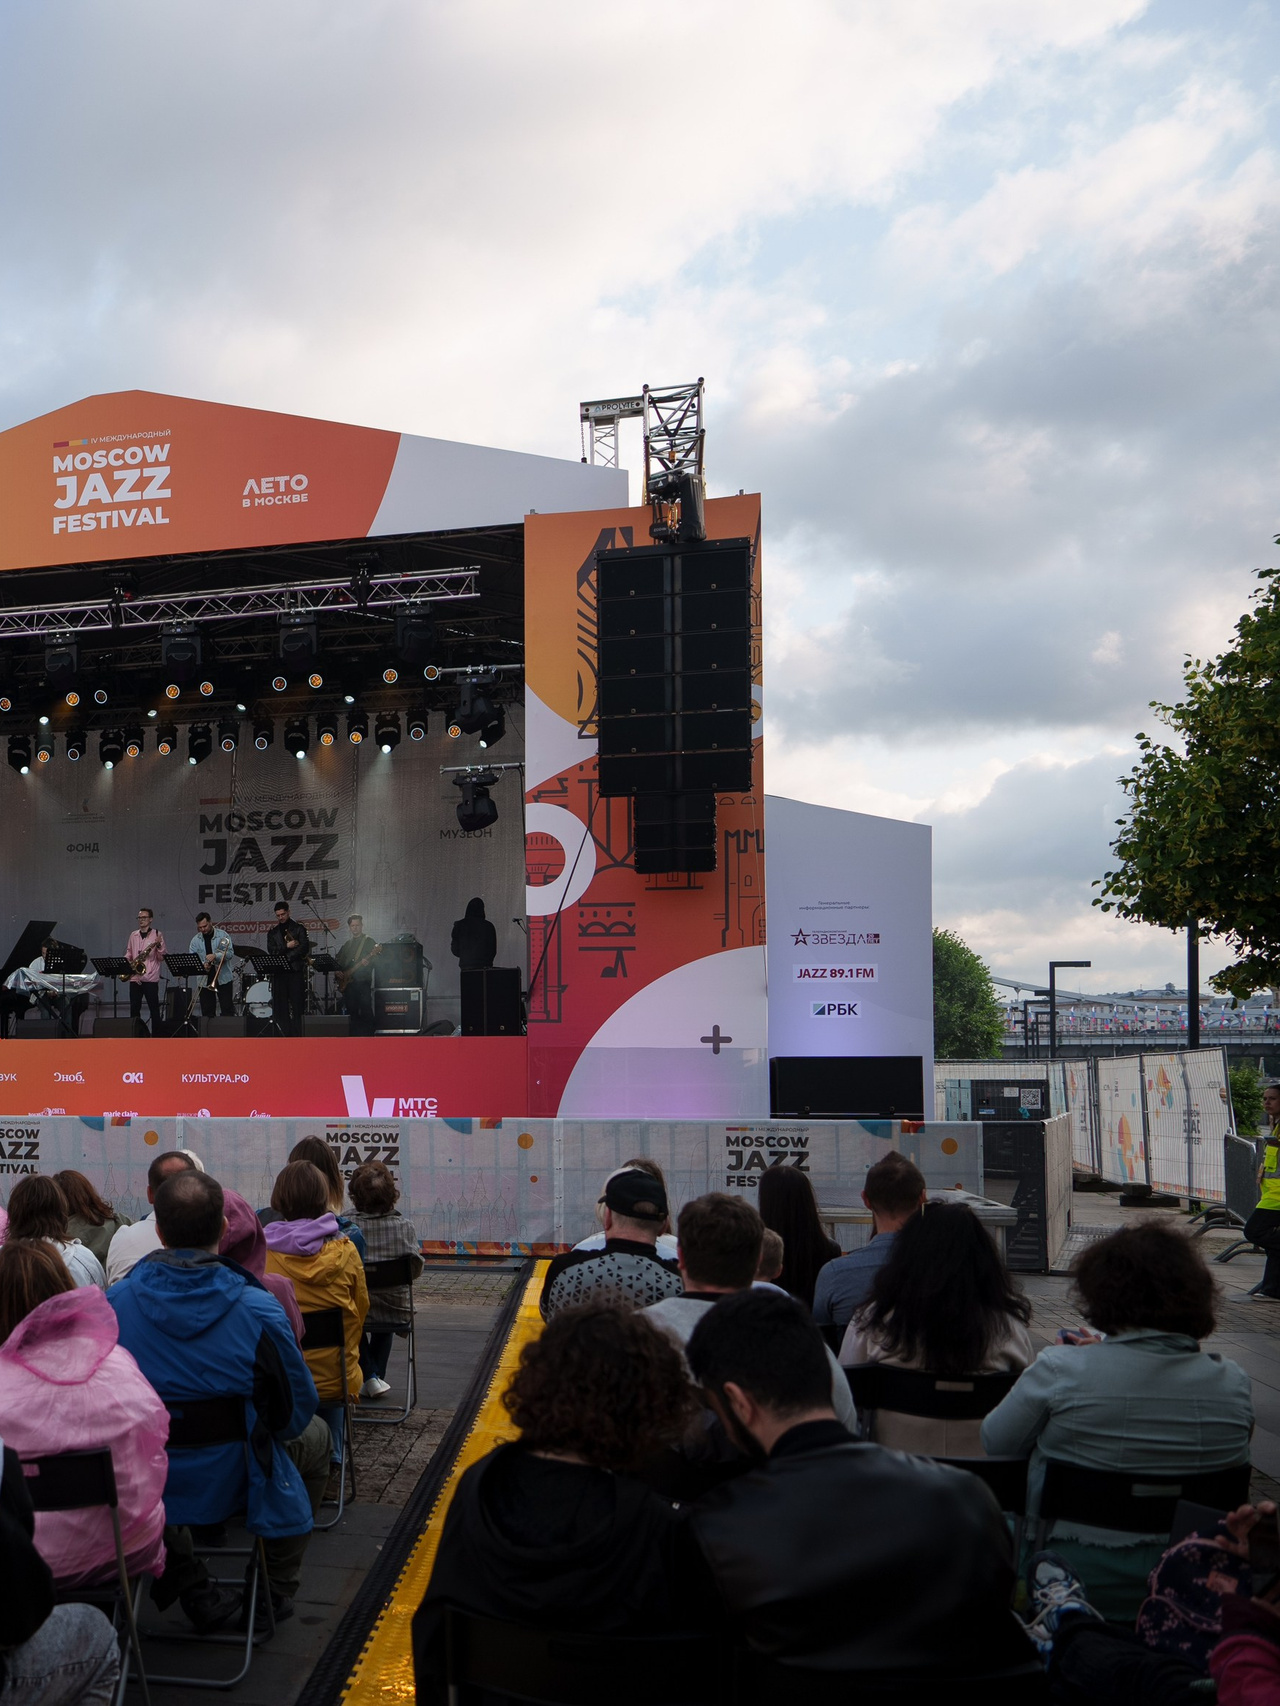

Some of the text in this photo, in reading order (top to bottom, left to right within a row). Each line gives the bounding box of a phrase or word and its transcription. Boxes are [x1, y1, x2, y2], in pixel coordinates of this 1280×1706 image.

[601, 402, 634, 411] PROLYTE
[99, 429, 171, 443] МЕЖДУНАРОДНЫЙ
[53, 443, 171, 473] MOSCOW
[53, 466, 171, 509] JAZZ
[243, 474, 309, 496] ЛЕТО
[242, 493, 308, 508] В МОСКВЕ
[53, 506, 170, 534] FESTIVAL
[199, 807, 339, 833] MOSCOW
[66, 842, 100, 853] ФОНД
[199, 833, 339, 876] JAZZ
[198, 880, 337, 904] FESTIVAL
[812, 933, 866, 946] ЗВЕЗДА
[797, 968, 874, 979] JAZZ 89.1 FM
[827, 1003, 858, 1016] РБК
[122, 1072, 144, 1084] OK!
[181, 1073, 250, 1084] КУЛЬТУРА.РФ
[326, 1132, 400, 1144] MOSCOW
[726, 1136, 810, 1148] MOSCOW
[726, 1150, 810, 1171] JAZZ
